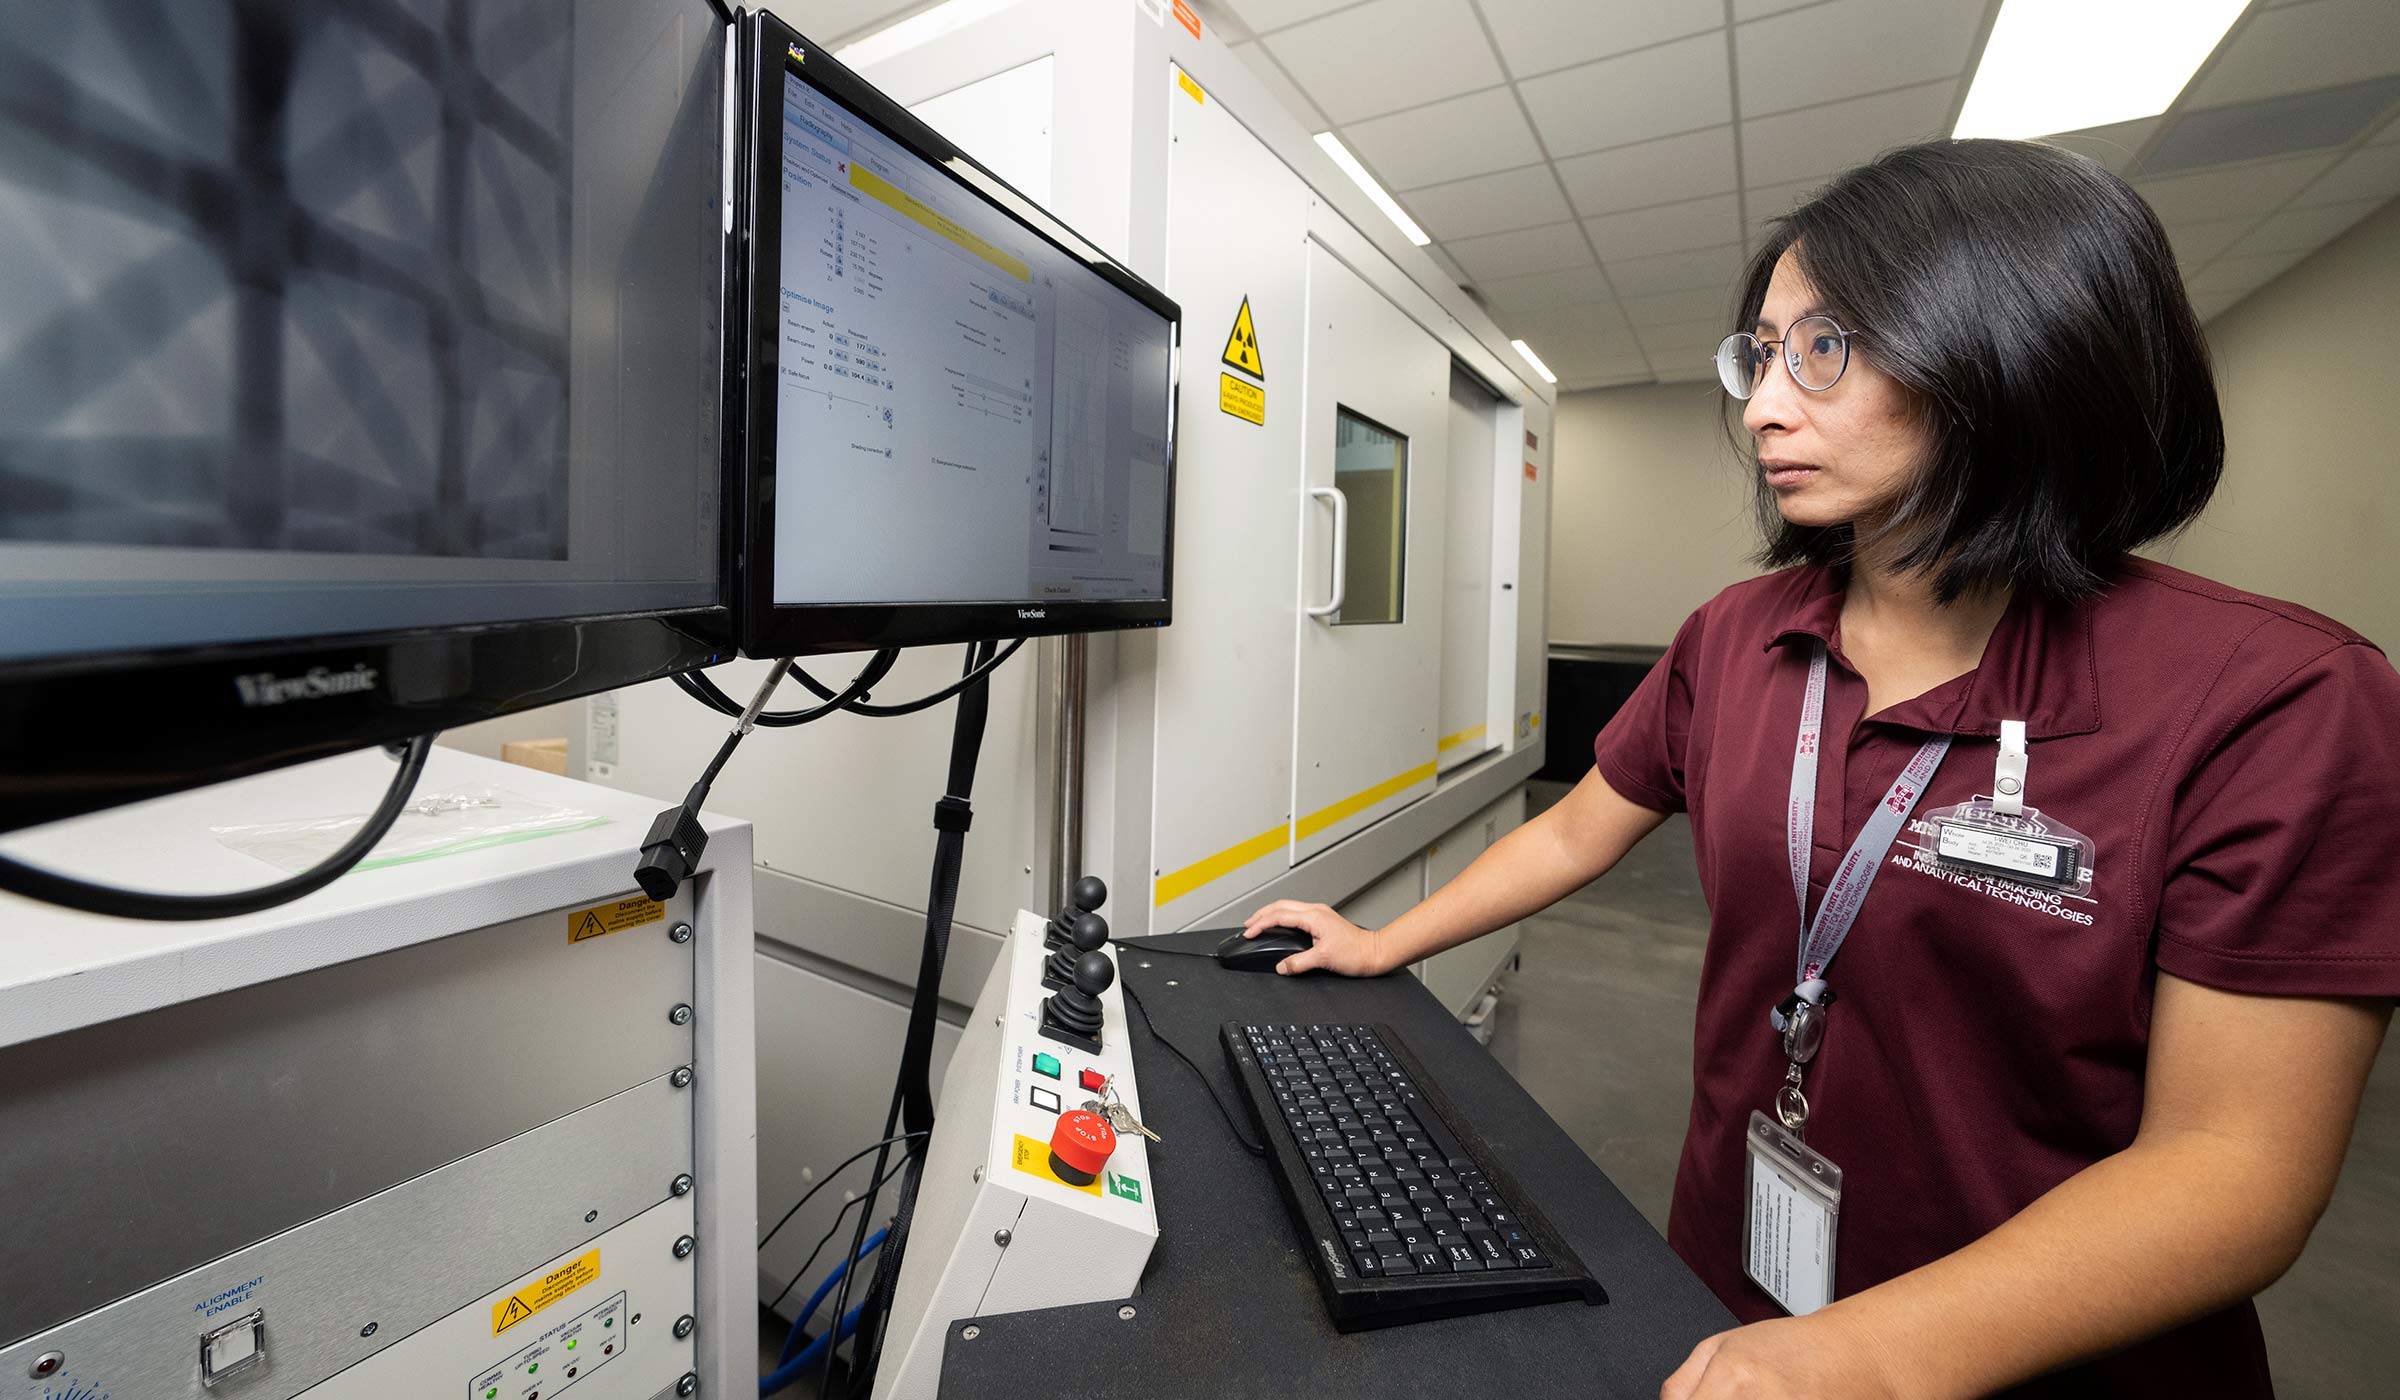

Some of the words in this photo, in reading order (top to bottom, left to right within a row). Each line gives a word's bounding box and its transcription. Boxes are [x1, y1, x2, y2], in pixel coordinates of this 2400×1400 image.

[784, 132, 809, 152] System
[811, 148, 832, 165] Status
[784, 166, 812, 188] Position
[780, 287, 812, 304] Optimise
[814, 299, 834, 314] Image
[1018, 609, 1046, 618] ViewSonic
[234, 663, 377, 706] ViewSonic
[1913, 747, 1936, 778] INSTITUTE
[1920, 766, 1931, 780] AND
[1826, 892, 1839, 912] STATE
[1835, 851, 1860, 891] UNIVERSITY
[1847, 860, 1875, 908] TECHNOLOGIES
[1892, 855, 1911, 868] AND
[1912, 860, 1983, 892] ANALYTICAL
[1985, 884, 2094, 926] TECHNOLOGIES
[1969, 868, 1994, 886] FOR
[1998, 878, 2062, 905] IMAGING
[619, 898, 651, 911] Danger
[1836, 882, 1854, 912] IMAGING
[1073, 1115, 1090, 1123] STOP
[1075, 1127, 1097, 1142] STOP
[1016, 1140, 1024, 1165] EMERGENCY
[1392, 1212, 1402, 1220] W
[1322, 1240, 1347, 1278] KeySonic
[1365, 1258, 1373, 1268] Esc
[1451, 1247, 1461, 1260] Caps
[1461, 1248, 1472, 1260] Lock
[546, 1260, 582, 1284] Danger
[194, 1275, 265, 1312] ALIGNMENT
[206, 1291, 254, 1318] ENABLE
[539, 1322, 566, 1342] STATUS
[478, 1374, 504, 1392] HEALTHY
[480, 1370, 502, 1386] COMMS
[522, 1384, 536, 1395] OVER
